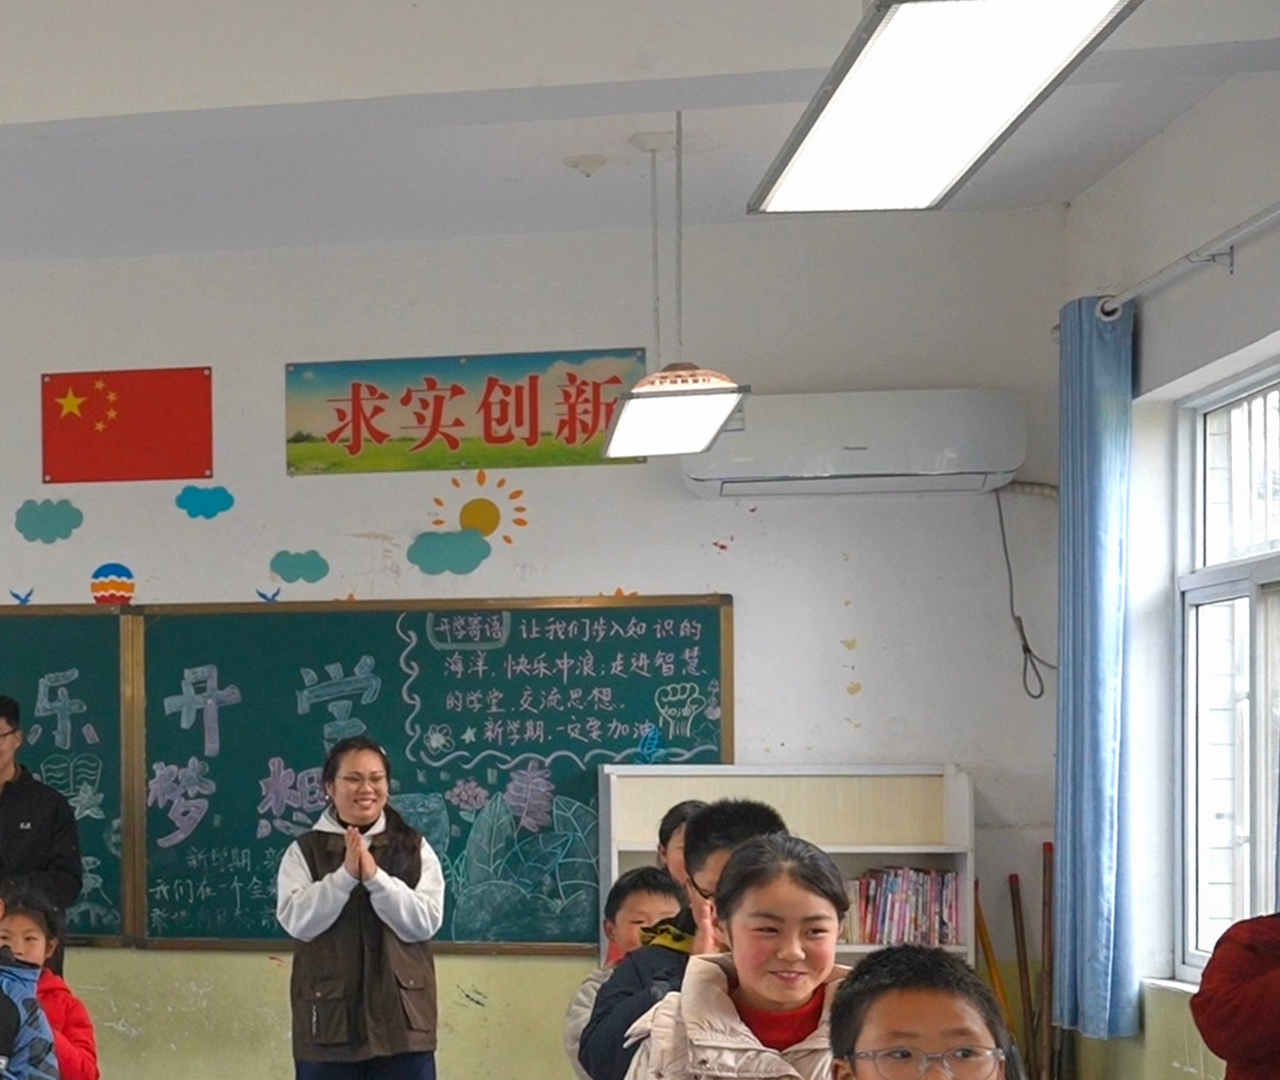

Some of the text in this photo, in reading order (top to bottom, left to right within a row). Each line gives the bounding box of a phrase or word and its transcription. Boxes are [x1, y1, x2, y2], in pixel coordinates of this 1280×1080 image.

[326, 372, 624, 456] 求实创新
[519, 617, 702, 643] 让我们步入知识的
